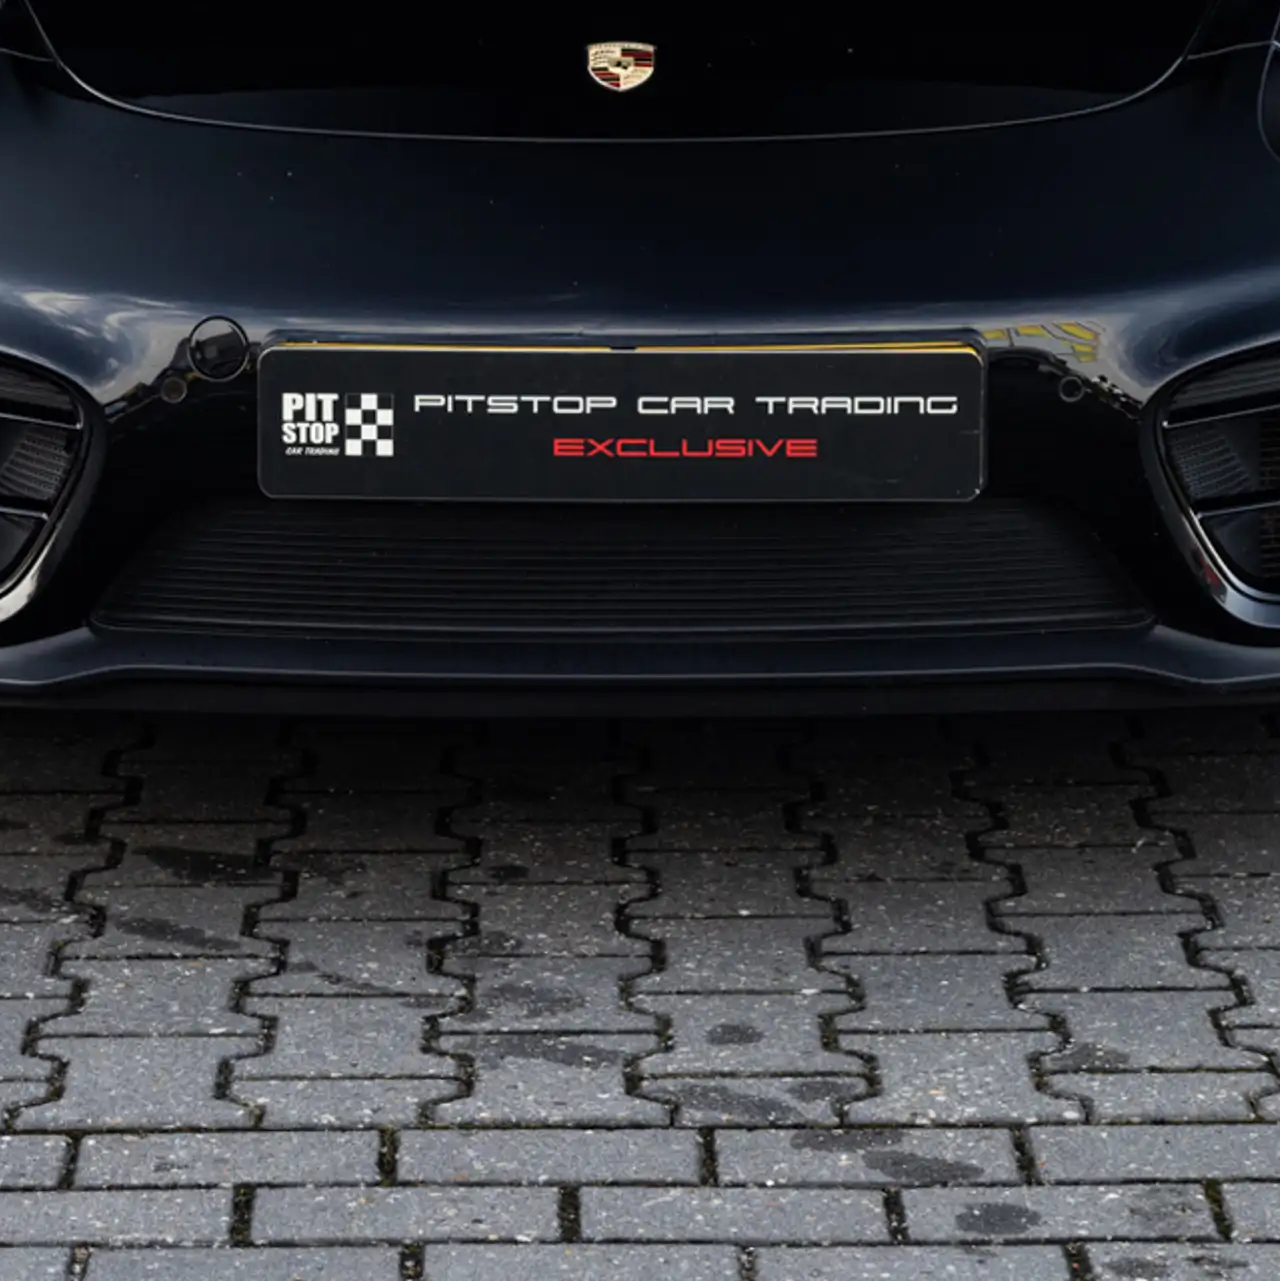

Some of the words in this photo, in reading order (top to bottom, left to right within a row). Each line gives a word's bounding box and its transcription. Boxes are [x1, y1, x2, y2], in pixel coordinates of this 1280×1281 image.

[282, 392, 340, 422] PIT
[413, 394, 618, 413] PITSTOP
[636, 396, 735, 415] CAR
[754, 396, 959, 415] TRADING
[282, 422, 340, 444] STOP
[553, 438, 819, 457] EXCLUSIVE
